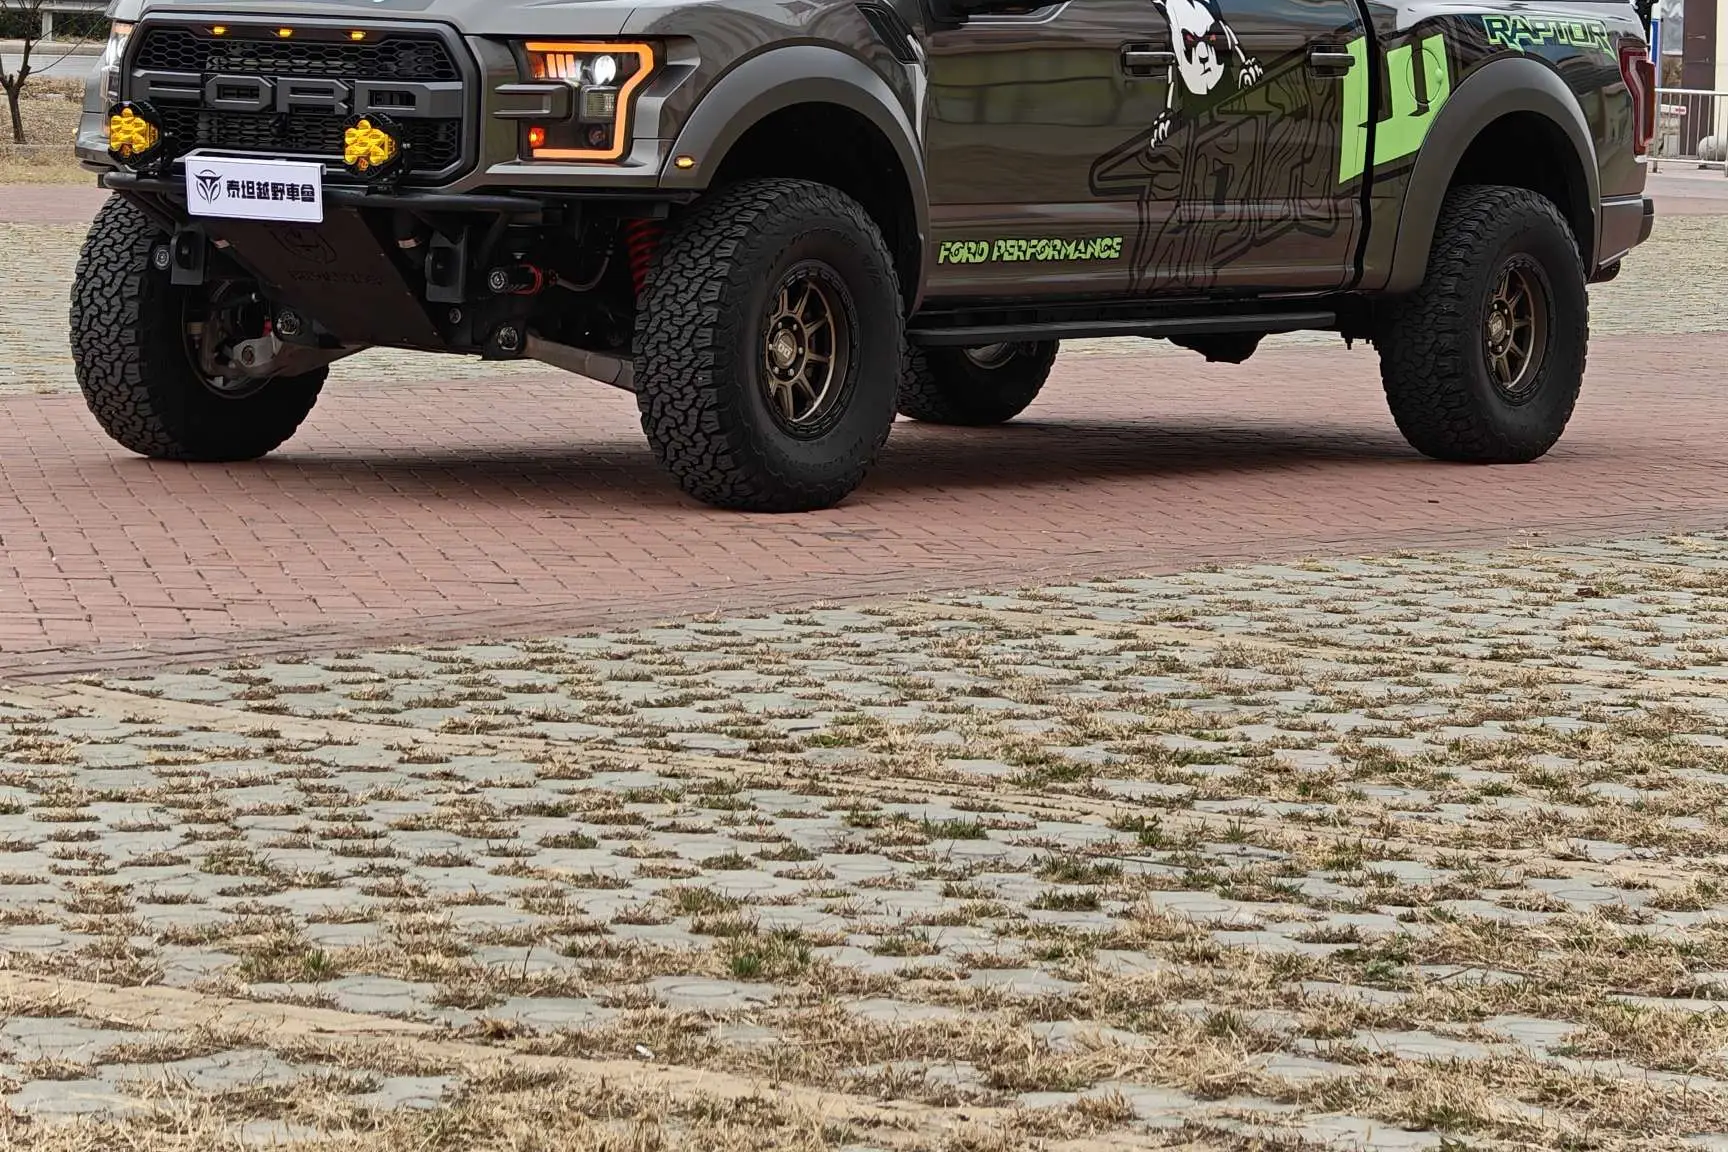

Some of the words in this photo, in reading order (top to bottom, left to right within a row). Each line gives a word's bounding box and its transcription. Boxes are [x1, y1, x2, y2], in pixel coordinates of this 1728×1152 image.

[1481, 15, 1617, 61] RAPTOR
[132, 69, 463, 119] FORD
[938, 242, 990, 264] FORD
[992, 237, 1122, 261] PERFORMANCE
